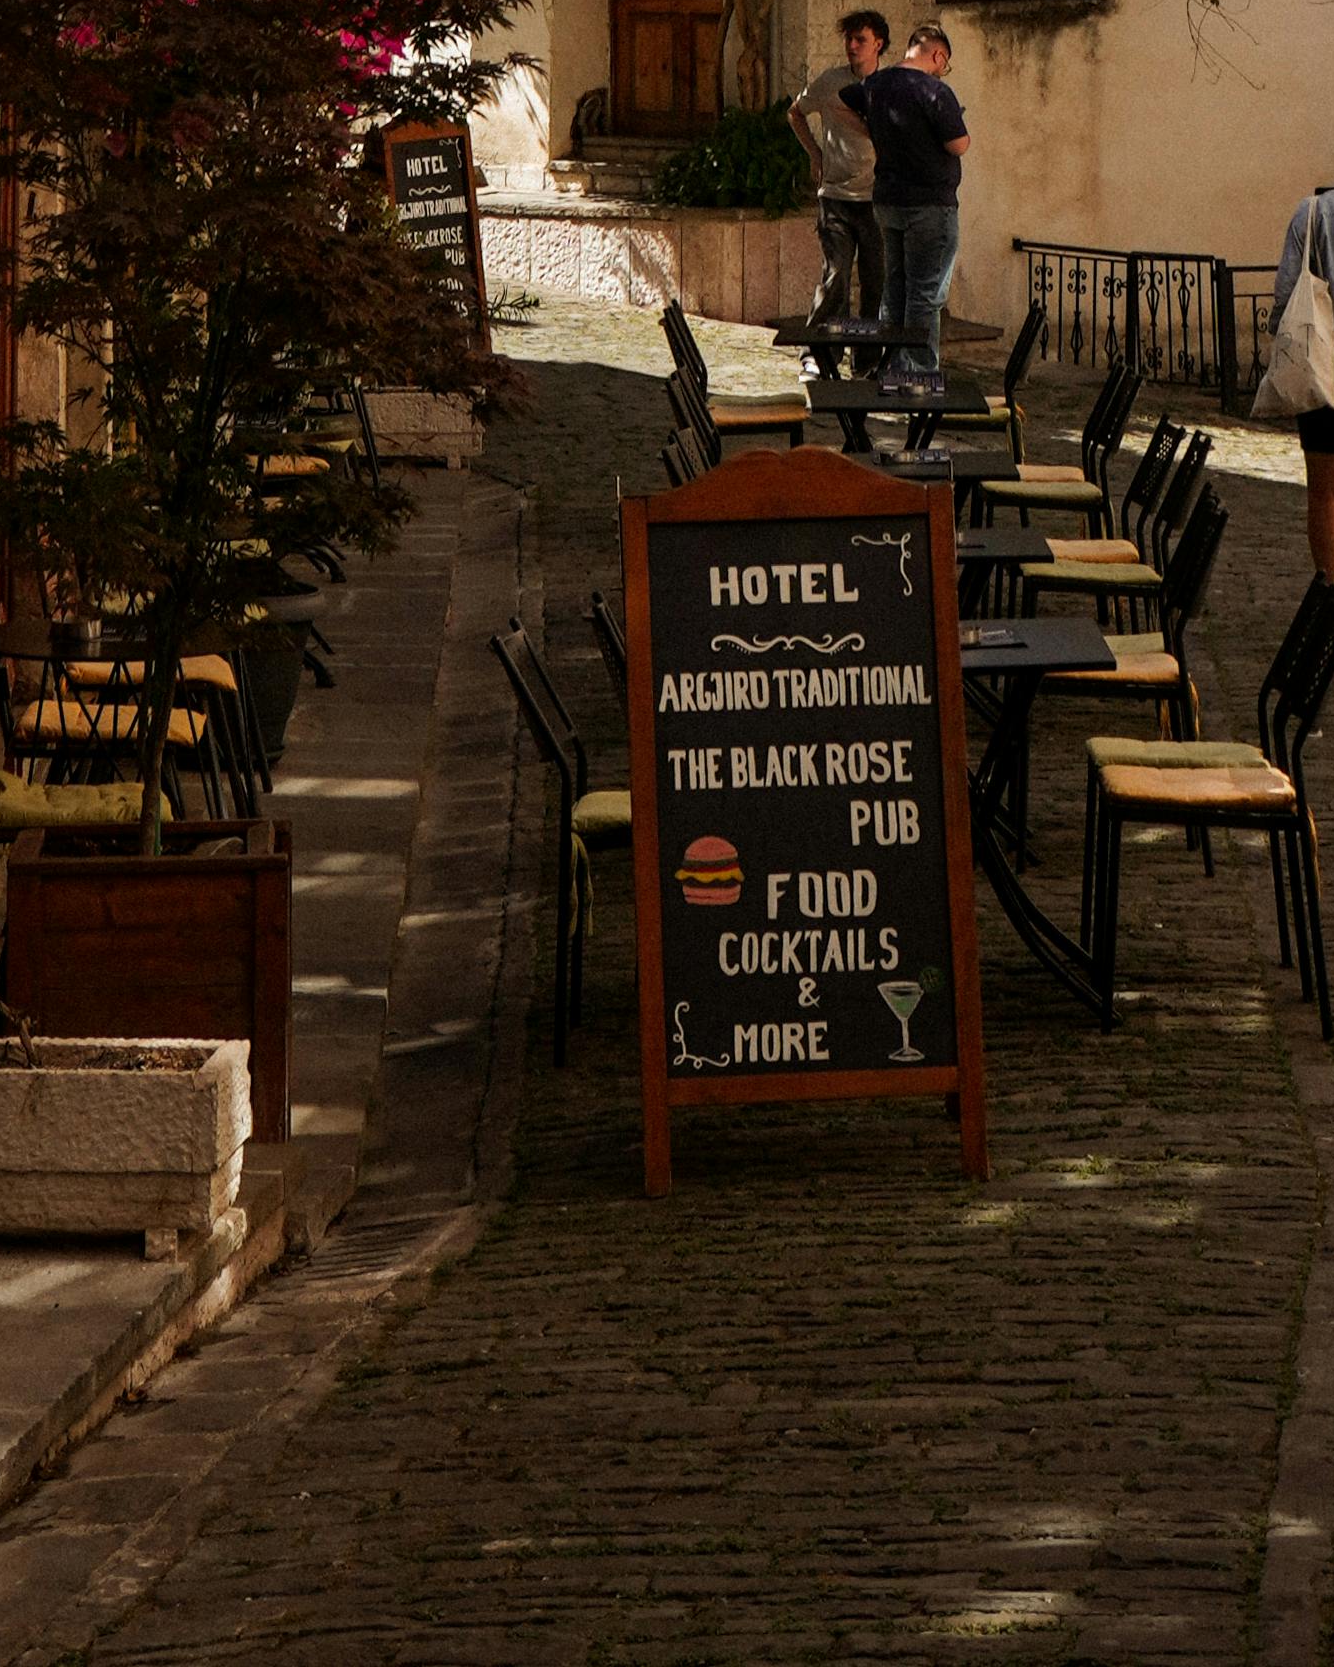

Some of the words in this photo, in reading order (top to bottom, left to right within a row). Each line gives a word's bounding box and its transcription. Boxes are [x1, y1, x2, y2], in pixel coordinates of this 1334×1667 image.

[406, 155, 448, 177] HOTEL
[440, 226, 463, 245] ROSE
[709, 563, 859, 606] HOTEL
[659, 671, 769, 712] ARGJIRO
[772, 665, 931, 708] TRADITIONAL
[668, 748, 723, 790] THE
[731, 744, 819, 788] BLACK
[825, 740, 913, 785] ROSE
[850, 800, 921, 846] PUB
[767, 869, 877, 919] FOOD
[719, 927, 899, 976] COCKTAILS
[798, 977, 820, 1008] &
[734, 1021, 830, 1063] MORE
